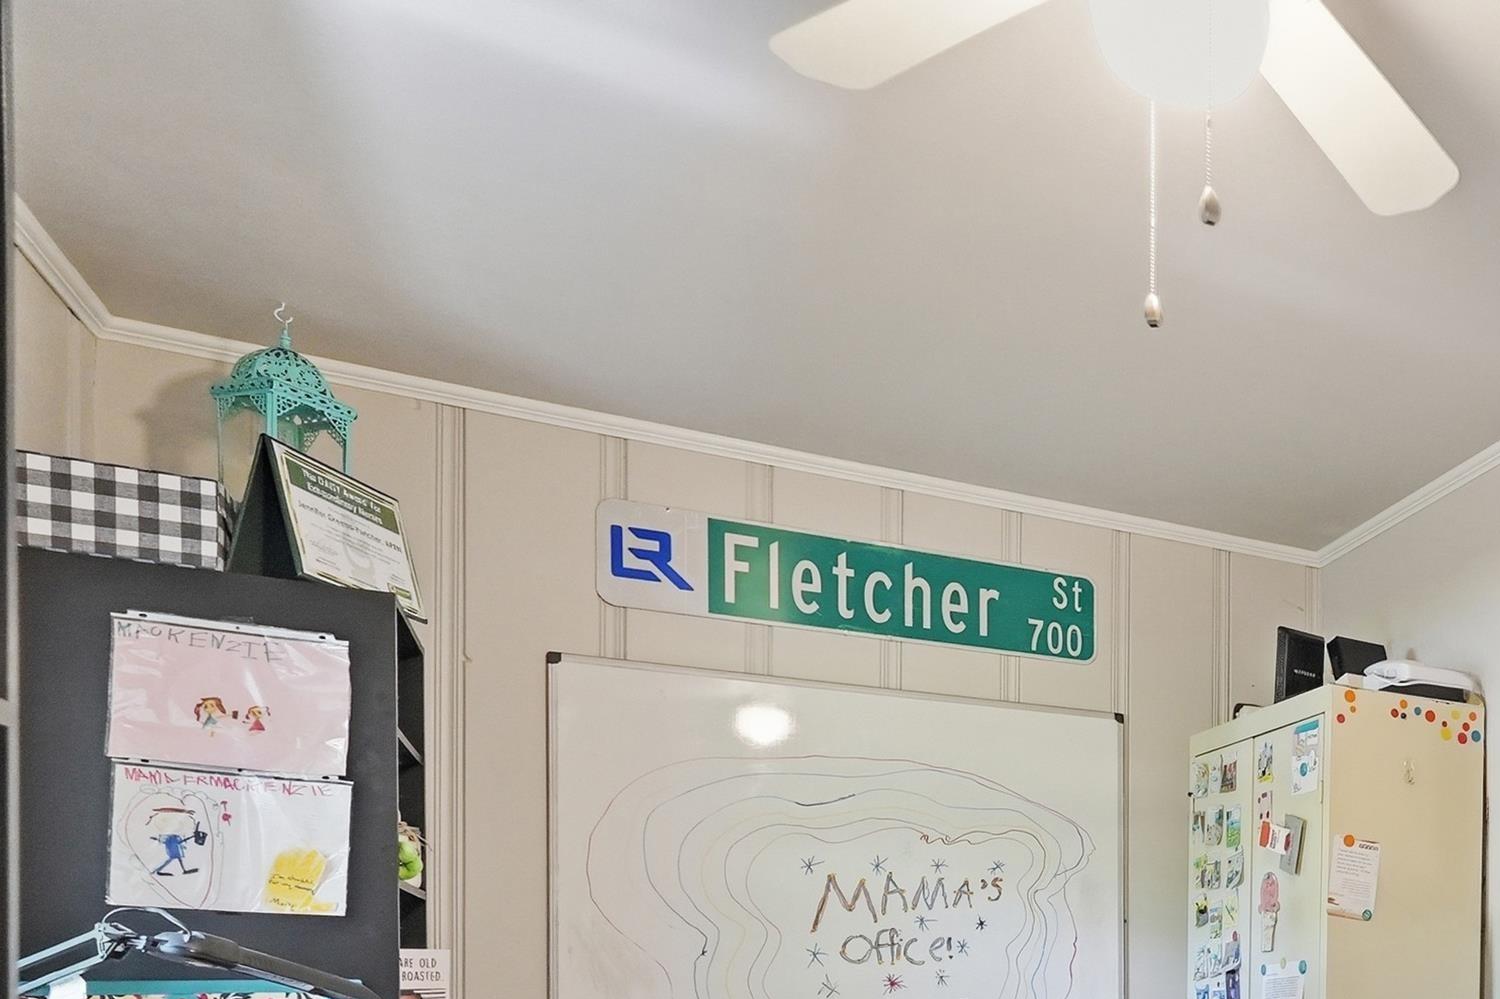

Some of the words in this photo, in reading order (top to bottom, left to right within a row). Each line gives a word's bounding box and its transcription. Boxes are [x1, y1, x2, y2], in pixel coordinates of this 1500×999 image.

[723, 531, 1001, 637] Fletcher
[1051, 576, 1083, 613] St
[1026, 618, 1083, 658] 700
[810, 871, 1004, 934] MAMA'S
[419, 957, 437, 969] OLD
